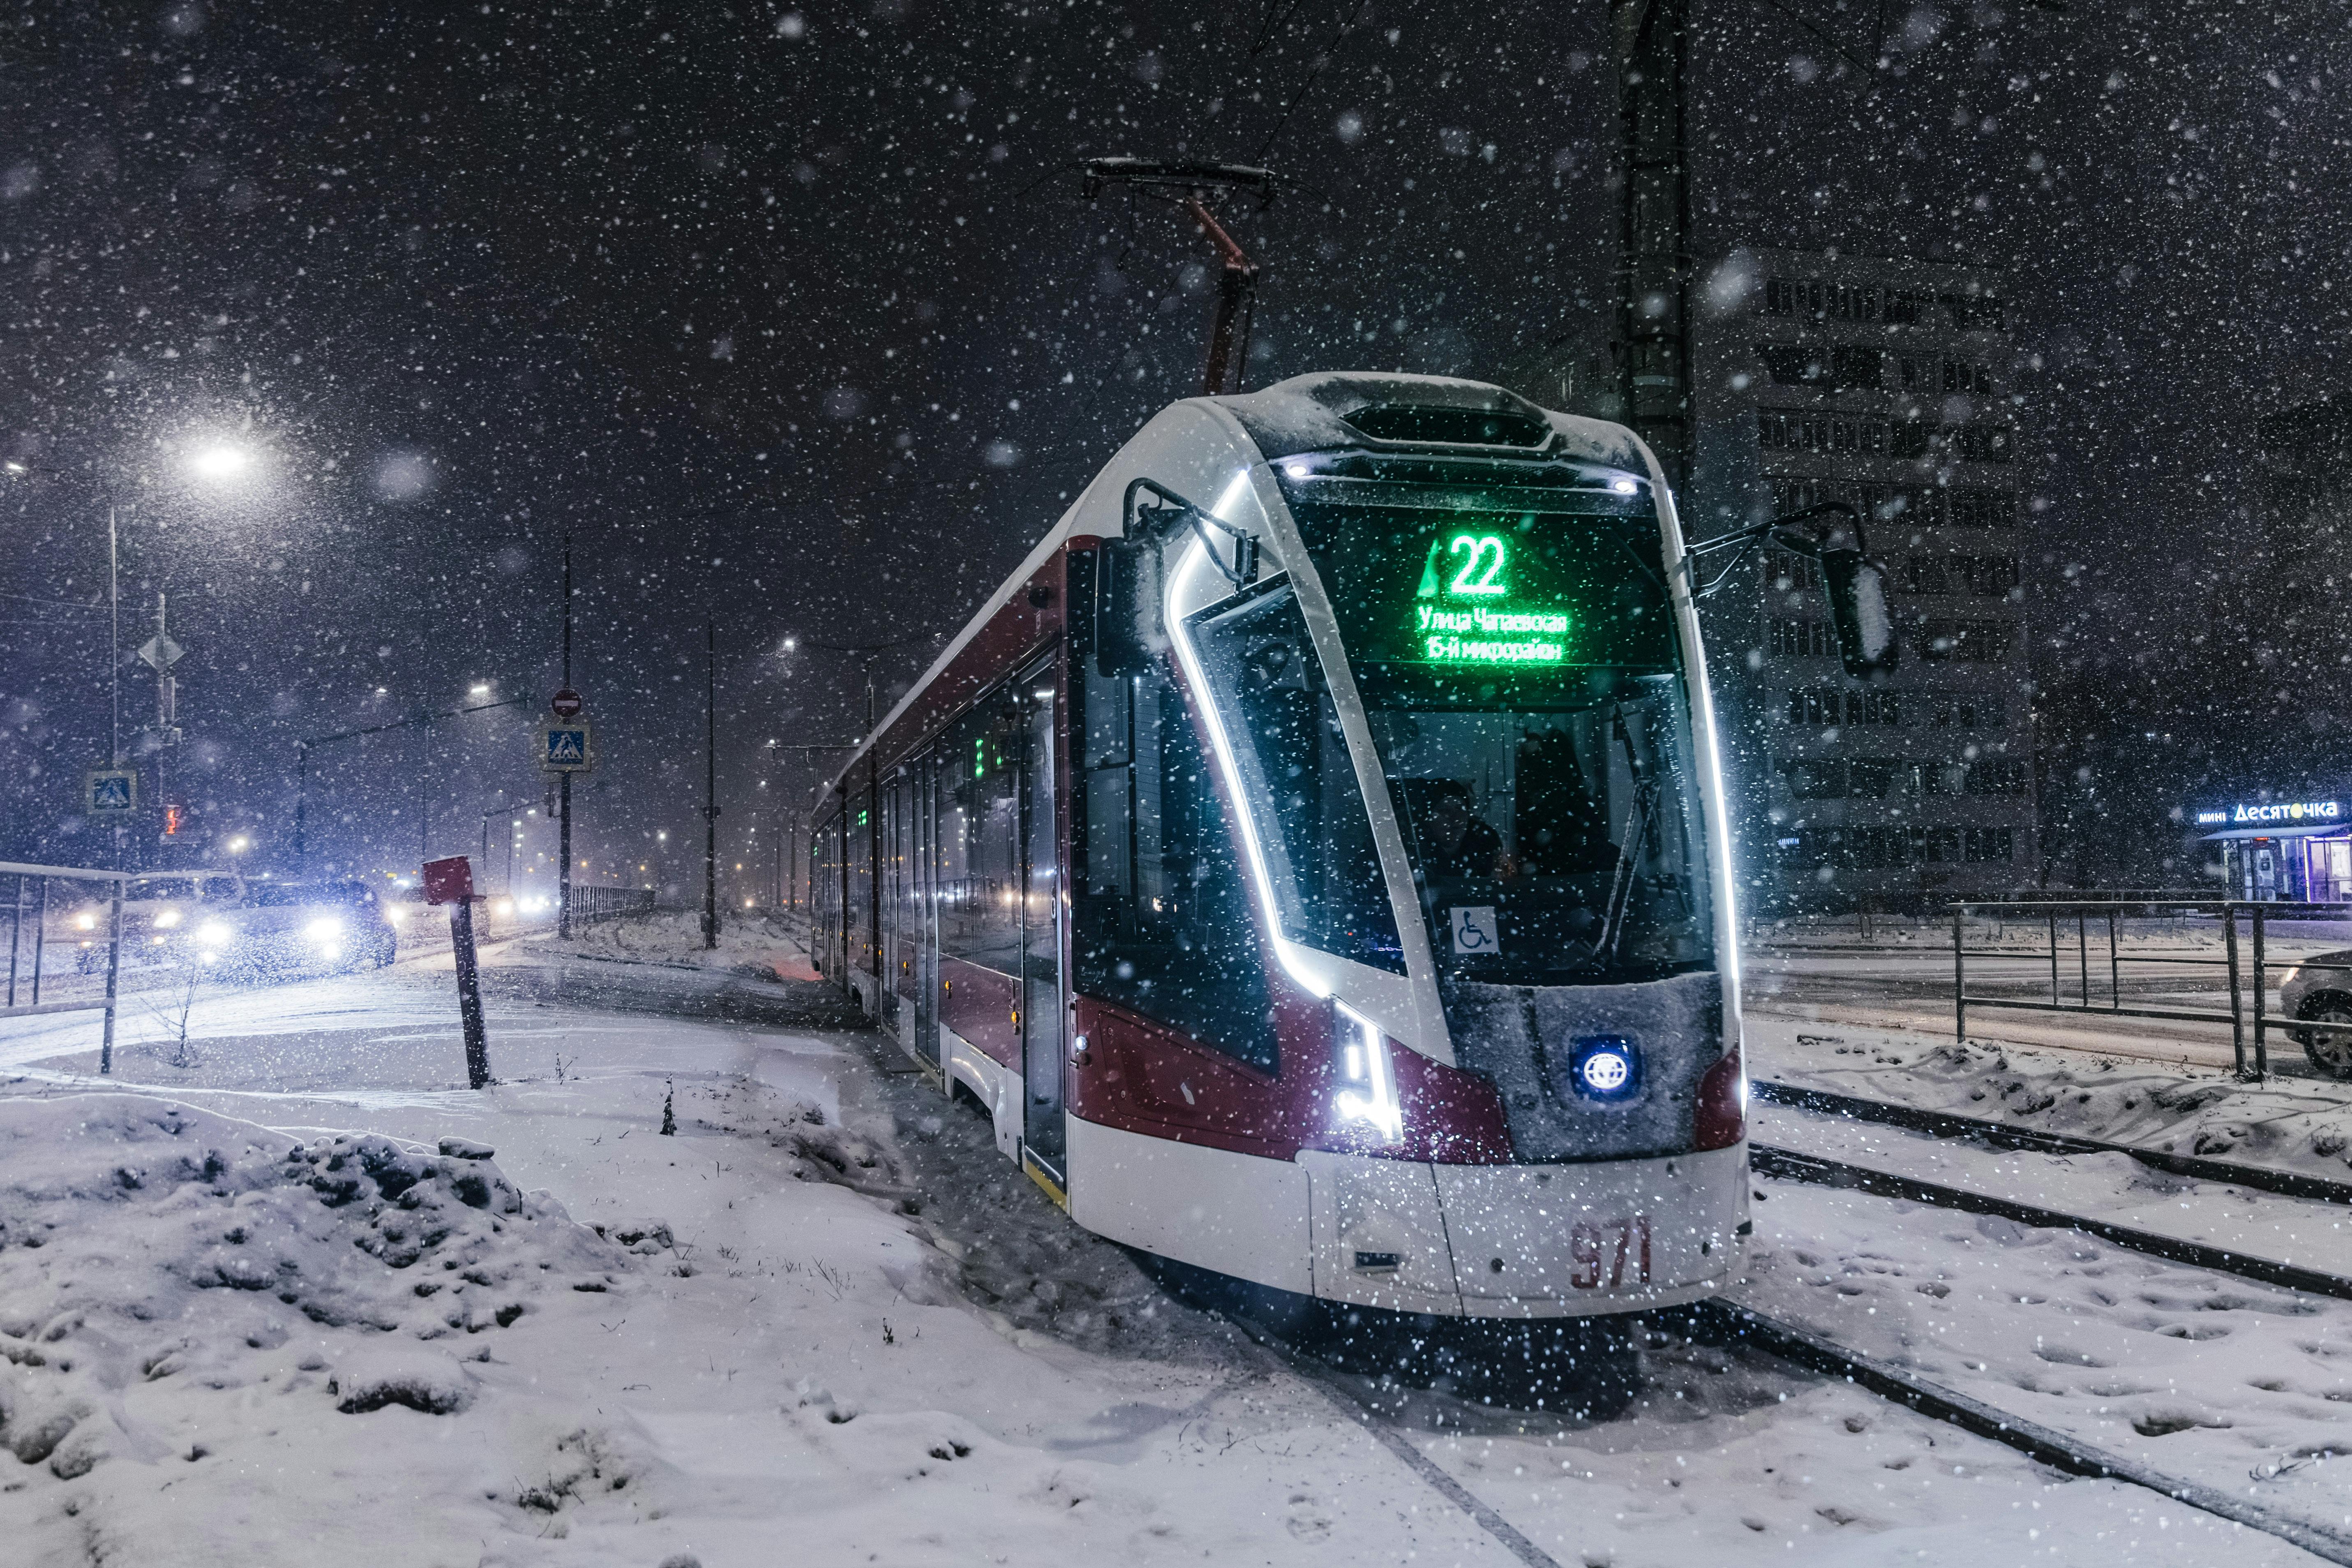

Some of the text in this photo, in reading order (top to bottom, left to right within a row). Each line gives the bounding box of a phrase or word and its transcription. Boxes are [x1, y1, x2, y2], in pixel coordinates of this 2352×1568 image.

[1451, 536, 1505, 593] 22
[1418, 605, 1567, 632] Улица Чапаевская
[1426, 636, 1562, 662] 15-й микрорайон
[2234, 801, 2338, 822] Десяточка
[1571, 1215, 1651, 1289] 971
